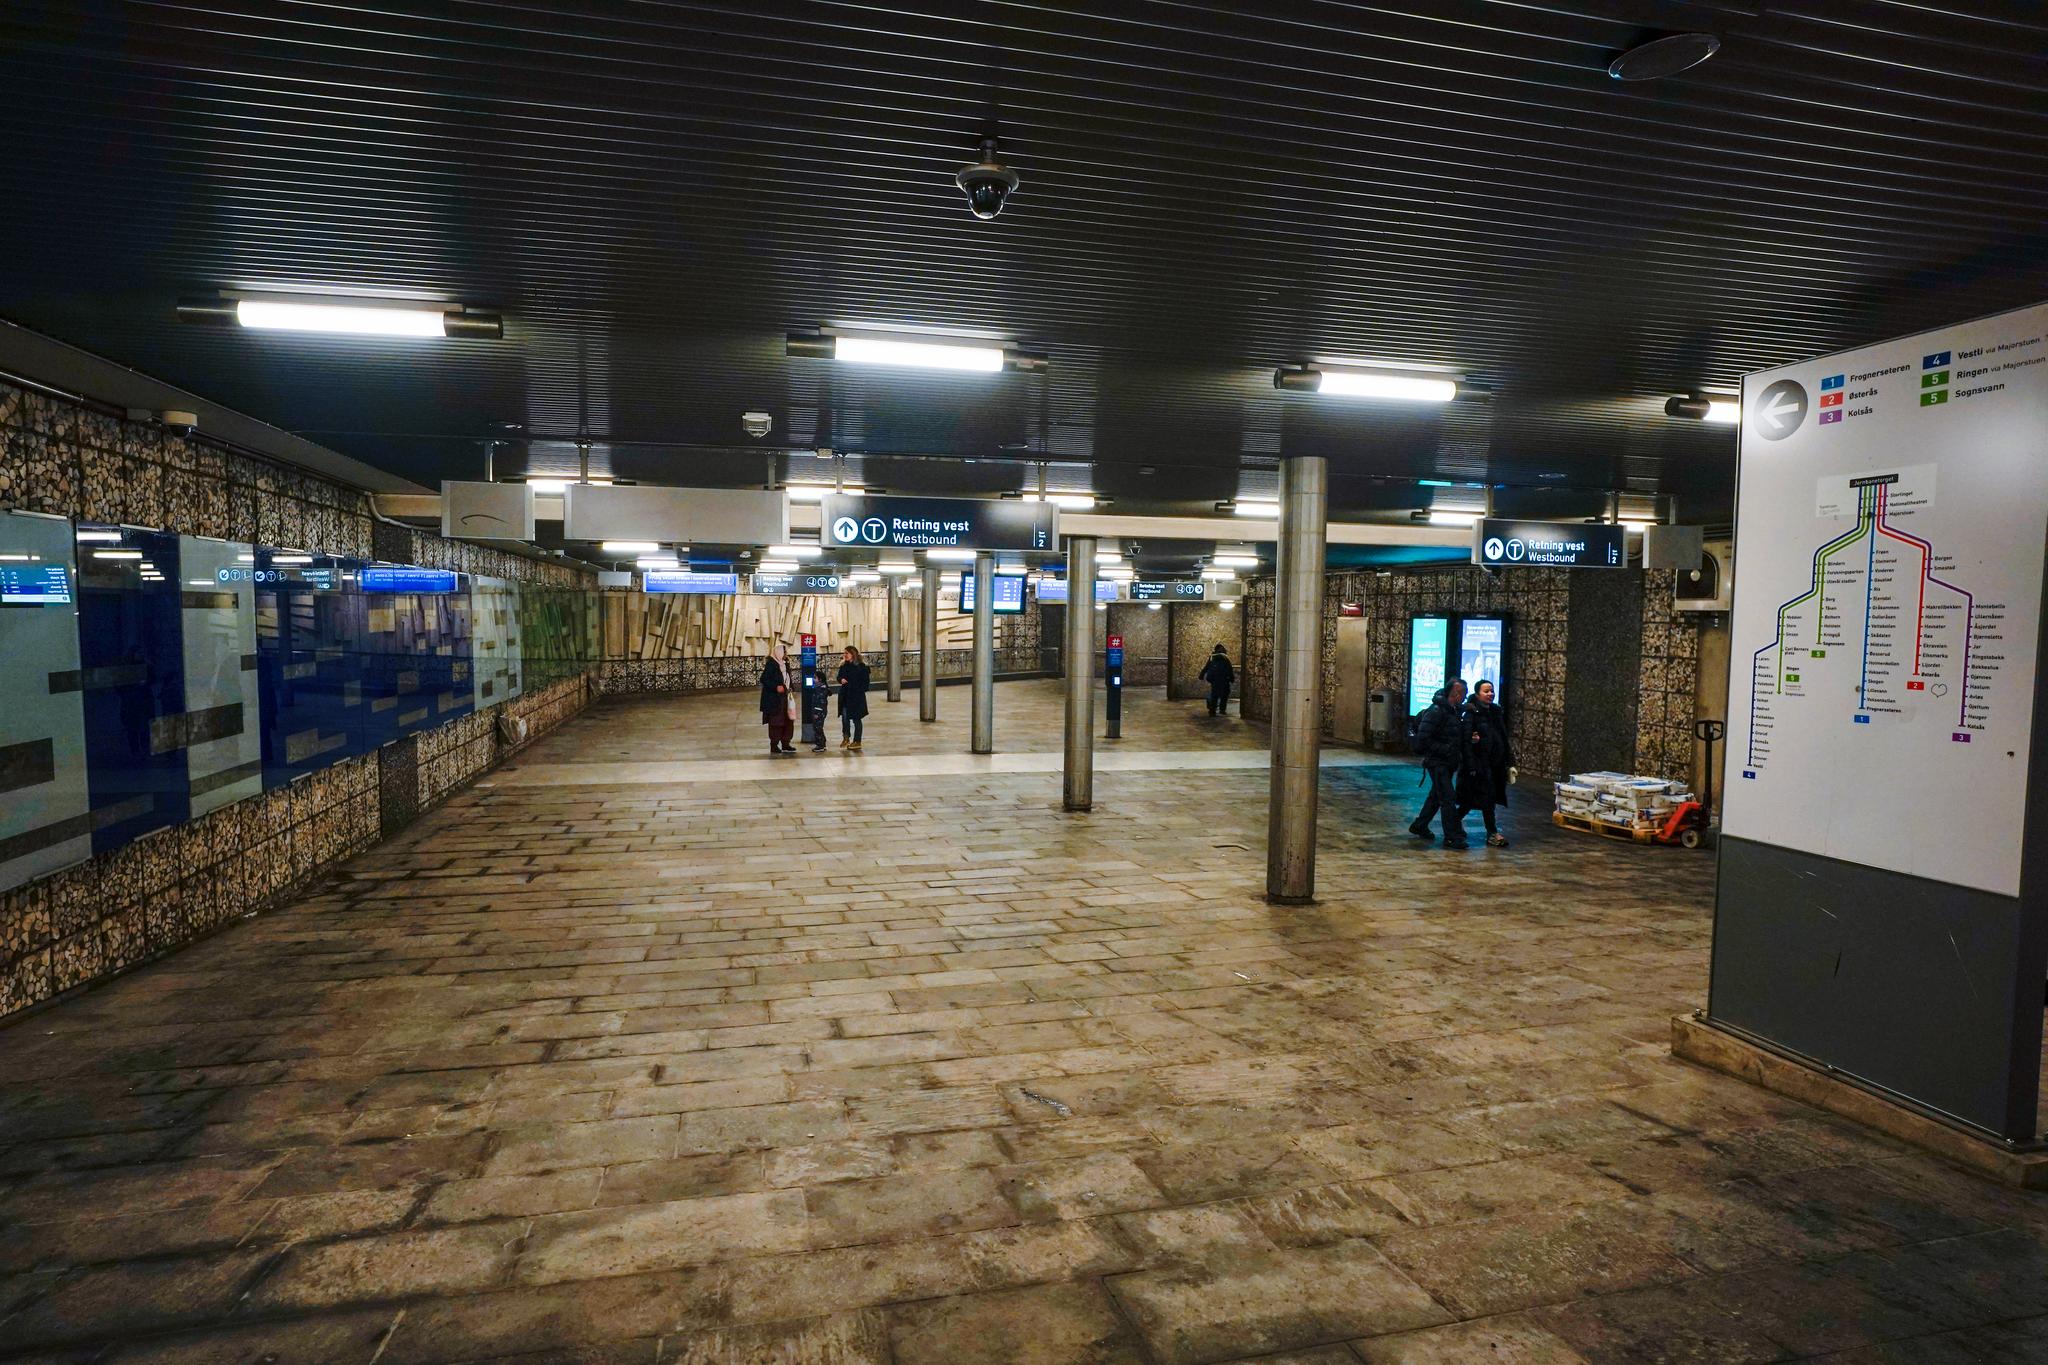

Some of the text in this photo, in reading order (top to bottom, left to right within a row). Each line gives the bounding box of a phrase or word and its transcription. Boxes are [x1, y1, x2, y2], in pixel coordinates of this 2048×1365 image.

[1957, 347, 1984, 360] Vestli
[1997, 337, 2040, 353] Majorstuen
[1932, 356, 1941, 366] 4
[1850, 363, 1911, 383] Frognerseteren
[1956, 356, 2046, 380] Ringen via Majorstuen
[1830, 378, 1835, 387] 1
[1932, 374, 1939, 385] 5
[1849, 387, 1879, 400] Østerås
[1955, 382, 2005, 399] Sognsvann
[1828, 395, 1835, 405] 2
[1930, 393, 1938, 404] 5
[1827, 412, 1834, 422] 3
[1848, 406, 1873, 418] Kolsås
[893, 518, 969, 533] Retning vest
[893, 532, 957, 545] Westbound
[1529, 539, 1585, 552] Retning vest
[1528, 552, 1575, 563] Westbound
